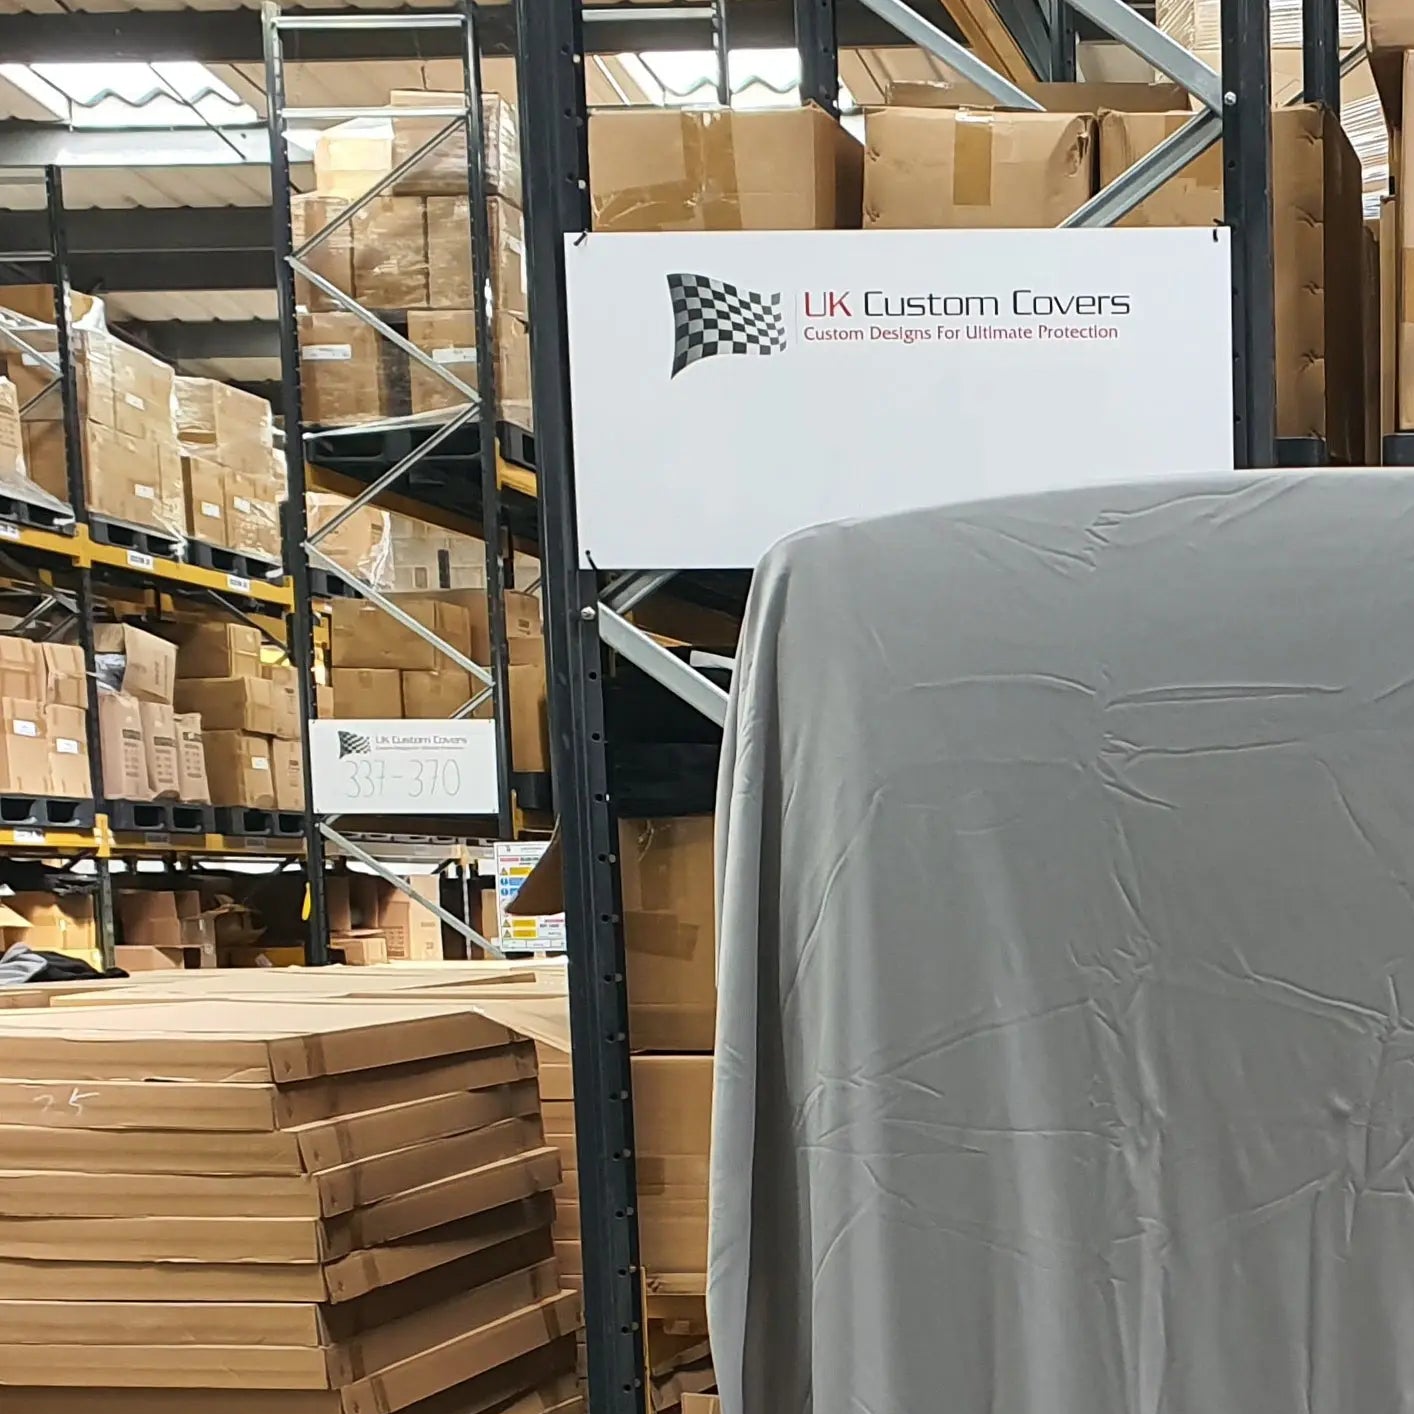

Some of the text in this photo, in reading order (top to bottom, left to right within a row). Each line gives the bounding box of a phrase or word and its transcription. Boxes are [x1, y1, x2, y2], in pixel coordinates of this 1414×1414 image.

[804, 289, 1131, 318] UK Custom Covers
[803, 324, 1118, 345] Custom Designs For Ultimate Protection
